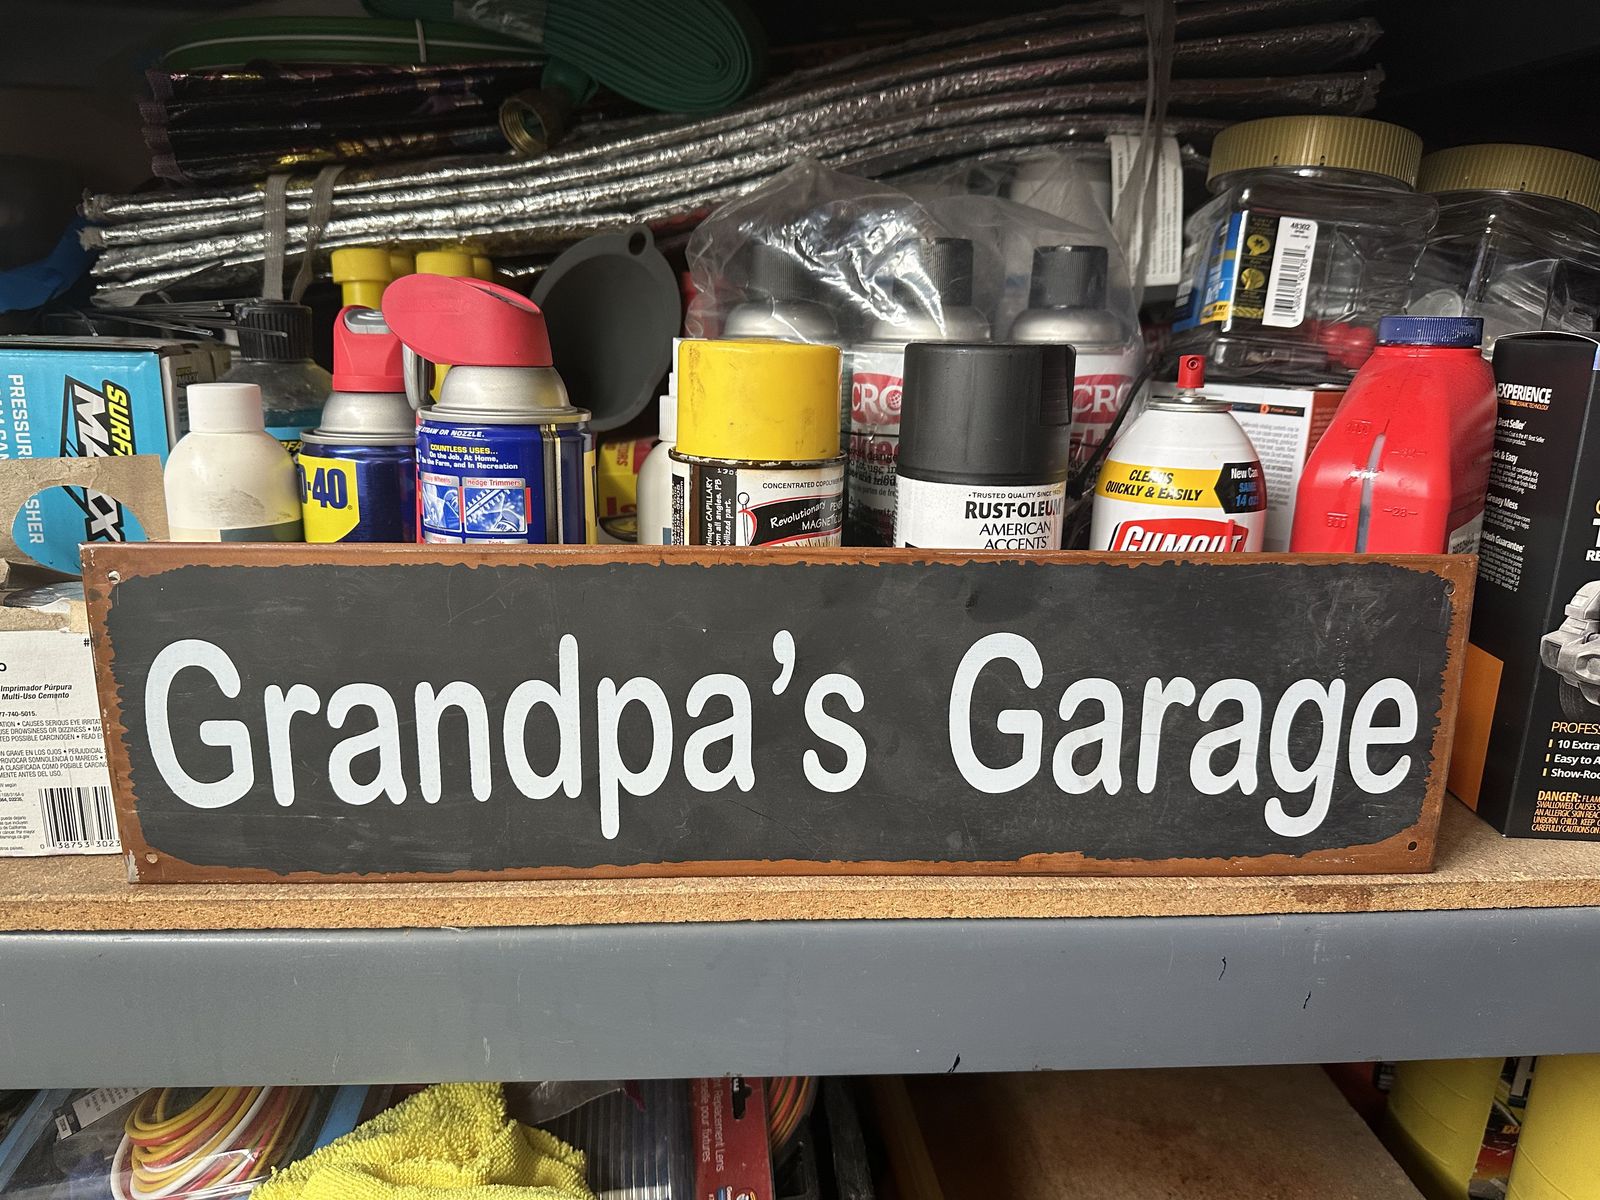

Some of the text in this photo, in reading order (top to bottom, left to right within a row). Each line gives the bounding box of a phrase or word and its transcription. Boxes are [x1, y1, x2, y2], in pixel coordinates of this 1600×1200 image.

[1496, 382, 1552, 404] EXPERIENCE
[8, 374, 33, 459] PRESSUR
[451, 430, 485, 438] NOZZLE.
[430, 443, 467, 453] COUNTLESS
[448, 453, 462, 461] Job,
[475, 455, 499, 463] Home,
[1506, 452, 1519, 465] Easy
[435, 459, 452, 468] Farm,
[477, 462, 518, 470] Recreation
[1231, 468, 1247, 479] New
[468, 479, 521, 487] Hedge Trimmers
[715, 479, 722, 490] PB
[762, 481, 815, 489] CONCENTRATED
[1105, 480, 1204, 501] QUICKLY & EASILY
[1236, 495, 1246, 506] 14
[1504, 498, 1518, 510] Mess
[725, 499, 734, 519] part.
[965, 498, 1061, 519] RUST-OLEUM
[770, 500, 826, 529] Revolutionary
[714, 522, 722, 531] all
[979, 521, 1051, 536] AMERICAN
[1, 683, 72, 693] Imprimador Púrpura
[38, 691, 69, 699] Cemento
[145, 630, 1418, 839] Grandpa's Garage
[1557, 740, 1570, 749] 10
[1554, 754, 1579, 766] Easy
[1580, 756, 1592, 765] to
[1537, 790, 1582, 803] DANGER:
[1574, 802, 1596, 811] CAUSES
[1544, 809, 1571, 817] ALLERGIC
[1571, 810, 1585, 818] SKIN
[1533, 816, 1559, 824] UNBORN
[1531, 823, 1562, 832] CAREFULLY
[1562, 824, 1590, 833] CAUTIONS
[701, 1105, 712, 1162] pour fixtures
[715, 1149, 725, 1172] Lens
